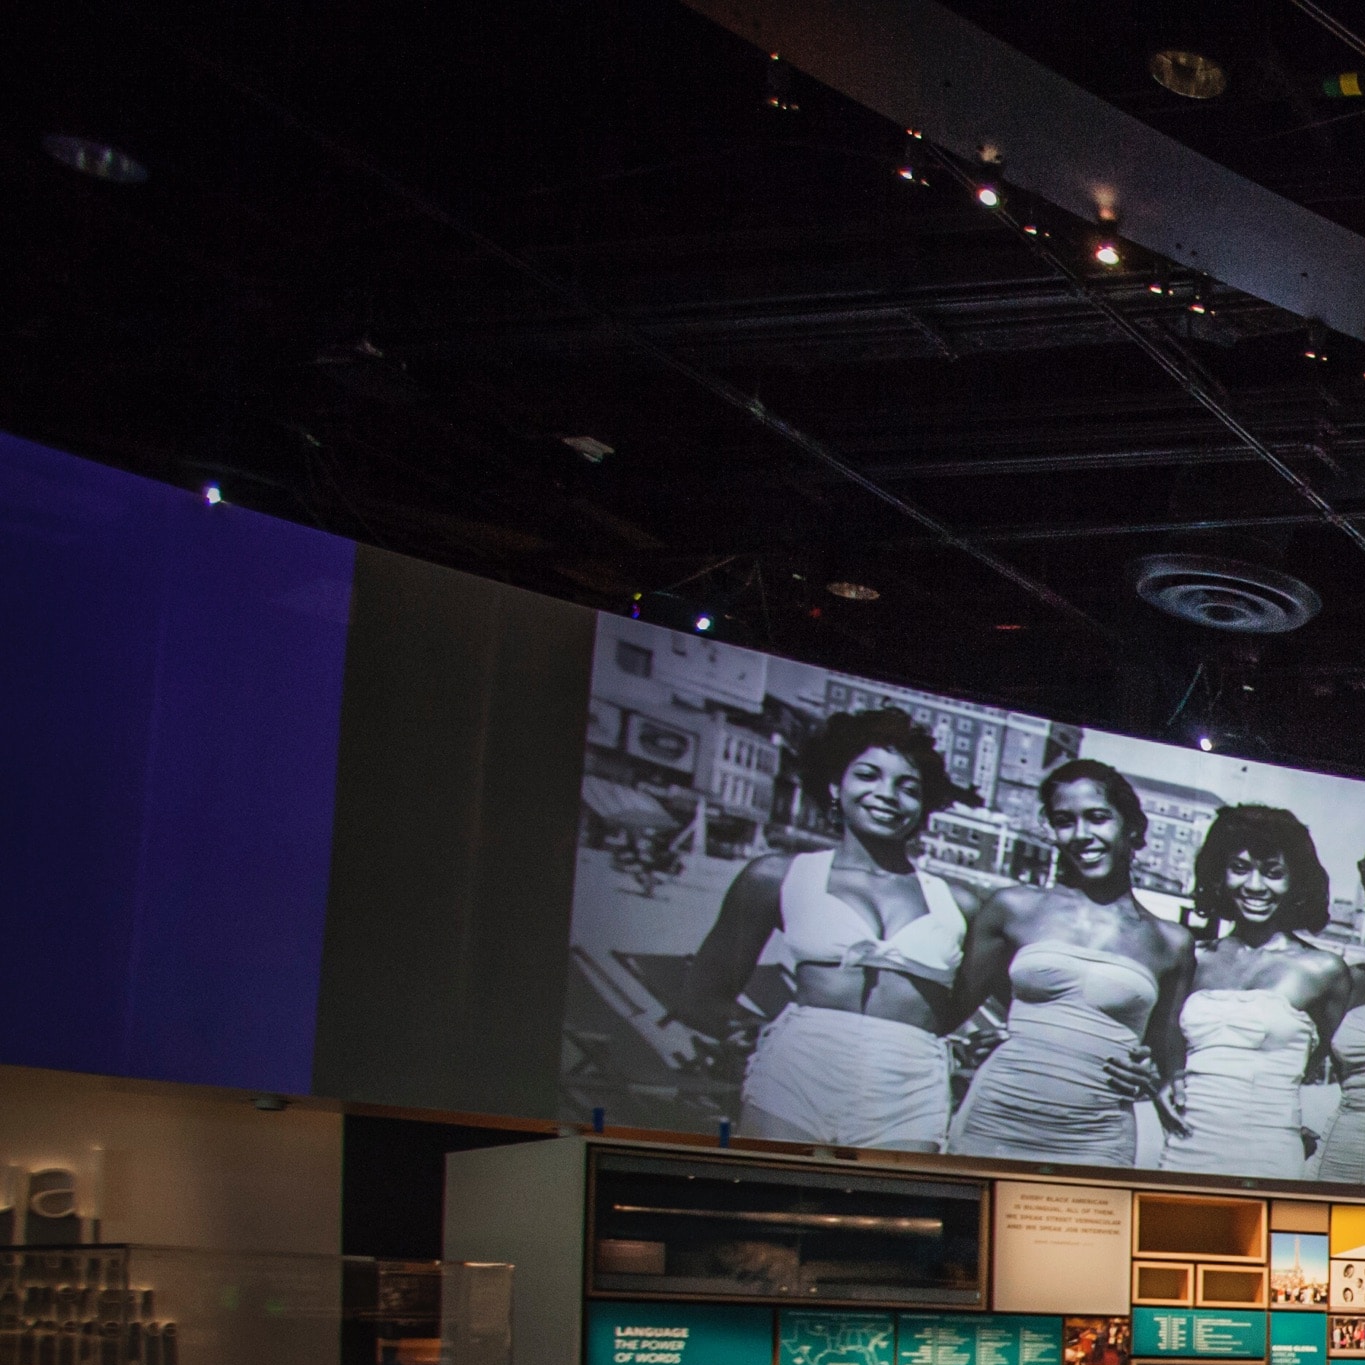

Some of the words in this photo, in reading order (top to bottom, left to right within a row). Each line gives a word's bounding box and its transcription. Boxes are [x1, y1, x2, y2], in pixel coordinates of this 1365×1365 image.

[614, 1326, 689, 1338] LANGUAGE
[614, 1339, 639, 1350] THE
[640, 1340, 686, 1351] POWER
[614, 1352, 634, 1363] OF
[635, 1353, 682, 1364] WORDS
